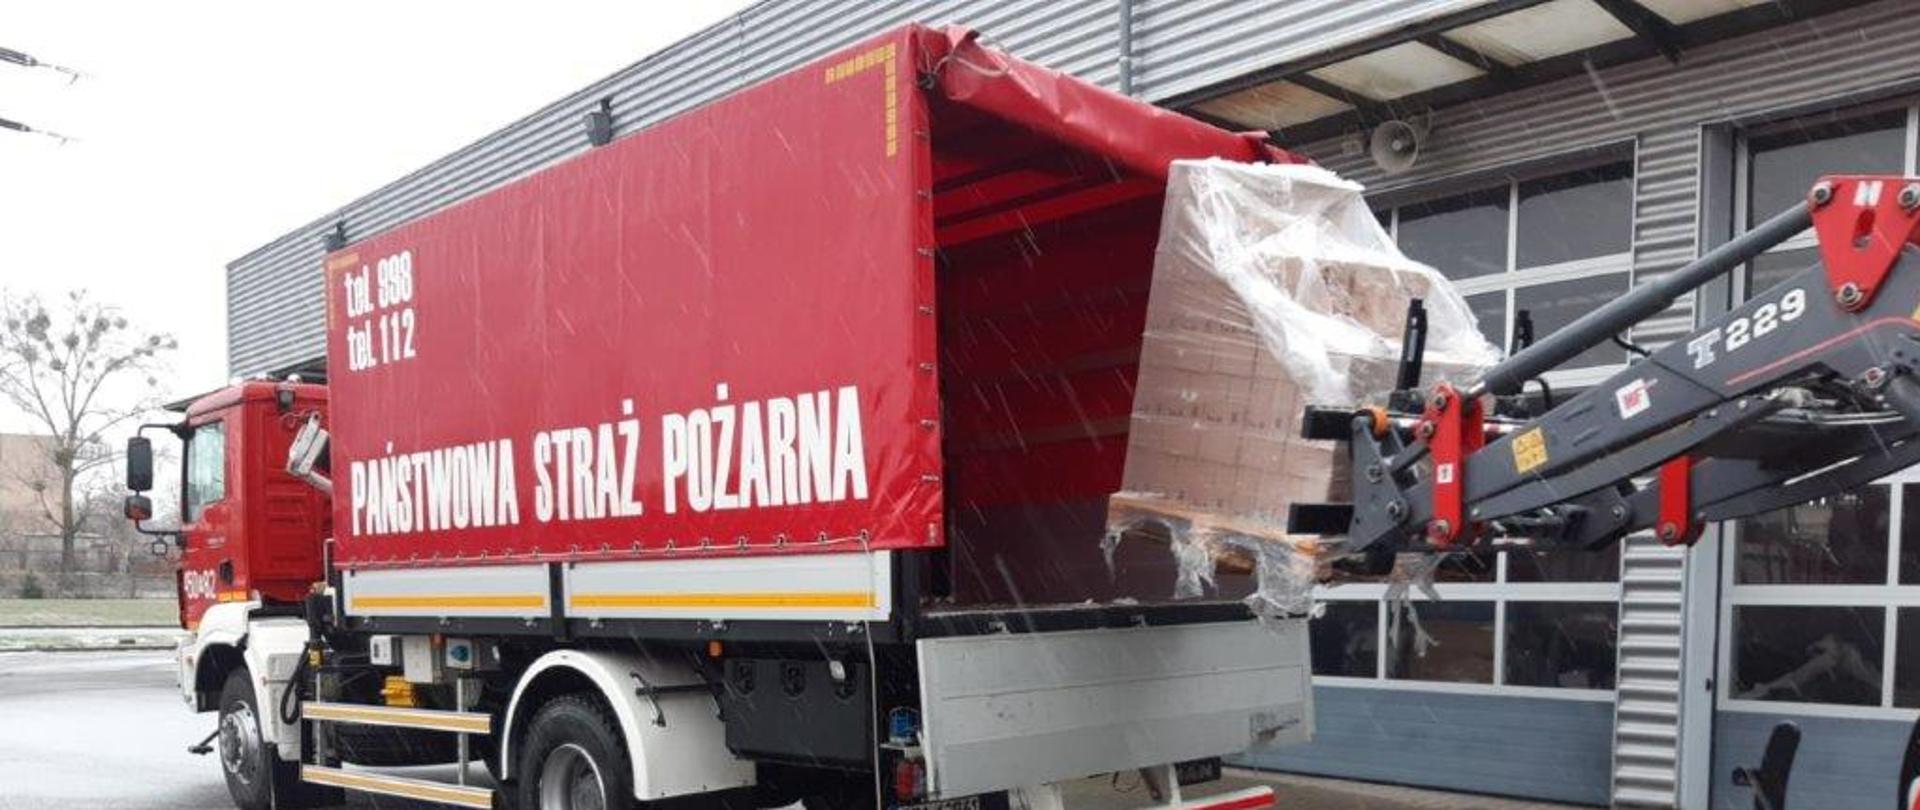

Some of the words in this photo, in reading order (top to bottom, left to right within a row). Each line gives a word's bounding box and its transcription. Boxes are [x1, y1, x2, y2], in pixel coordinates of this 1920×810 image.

[344, 265, 375, 317] tel.
[377, 250, 412, 308] 998
[347, 320, 377, 371] tel.
[379, 308, 416, 364] 112
[350, 438, 520, 536] PAŃSTWOWA
[533, 398, 643, 522] STRAŻ
[662, 382, 868, 514] POŻARNA
